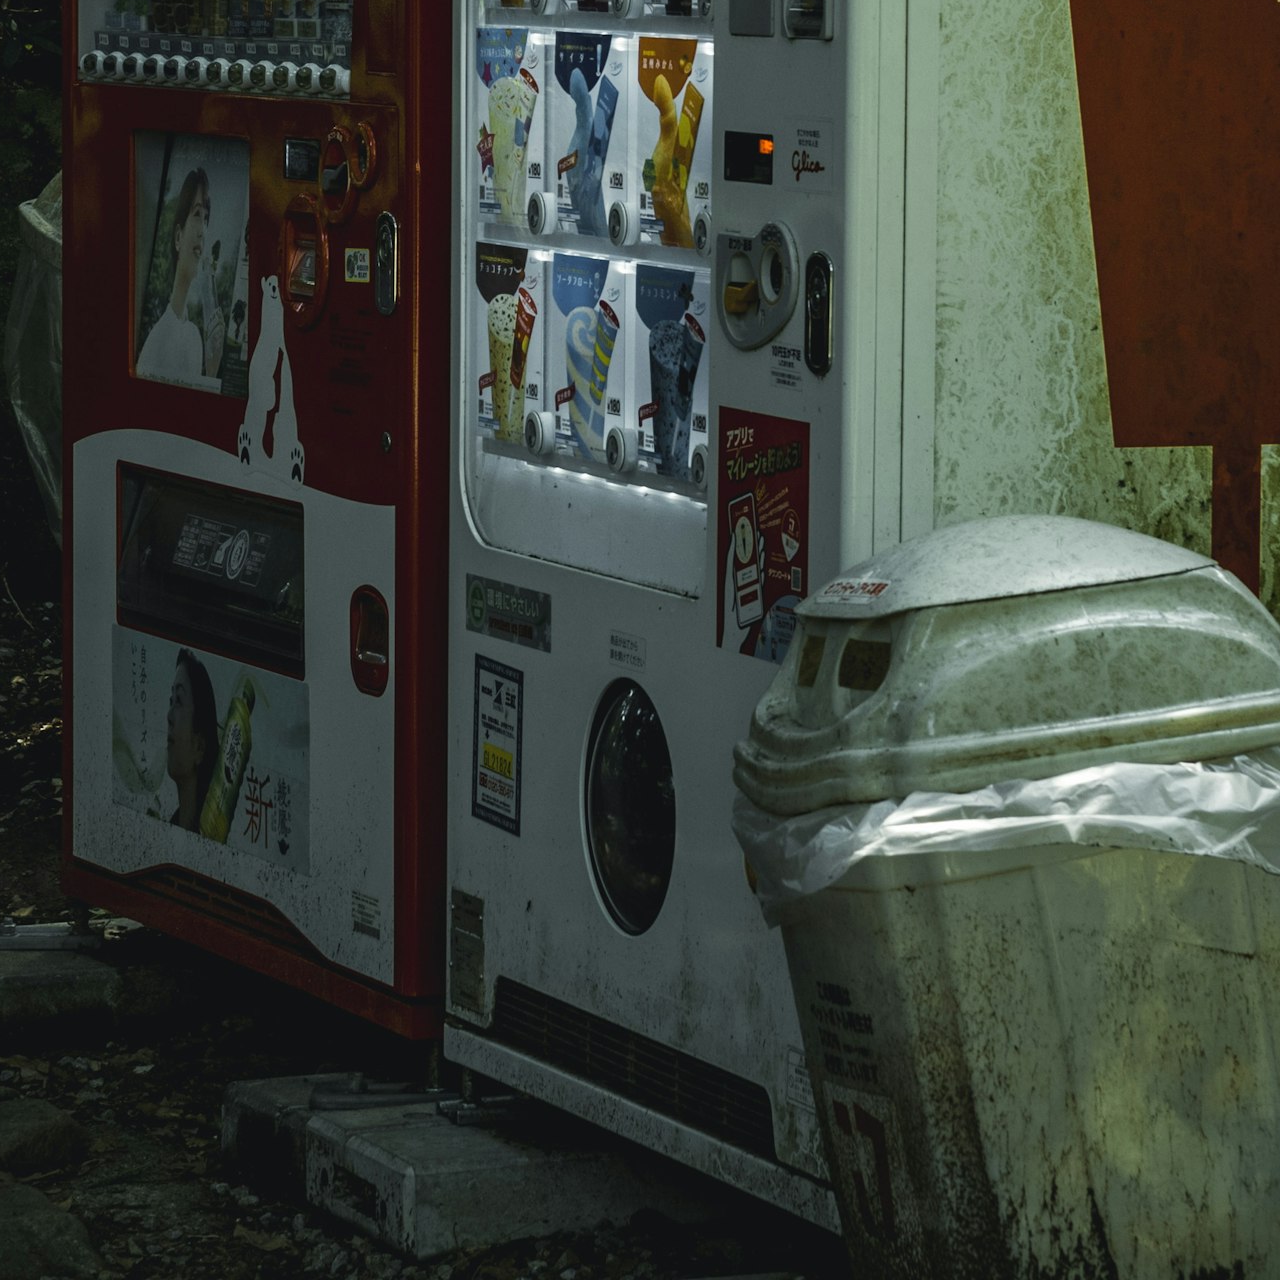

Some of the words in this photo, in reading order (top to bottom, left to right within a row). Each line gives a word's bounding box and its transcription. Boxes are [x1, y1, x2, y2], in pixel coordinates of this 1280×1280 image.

[792, 150, 825, 182] Glico
[726, 426, 754, 449] アプリで
[487, 588, 539, 618] 環境にやさしい
[243, 765, 273, 849] 新
